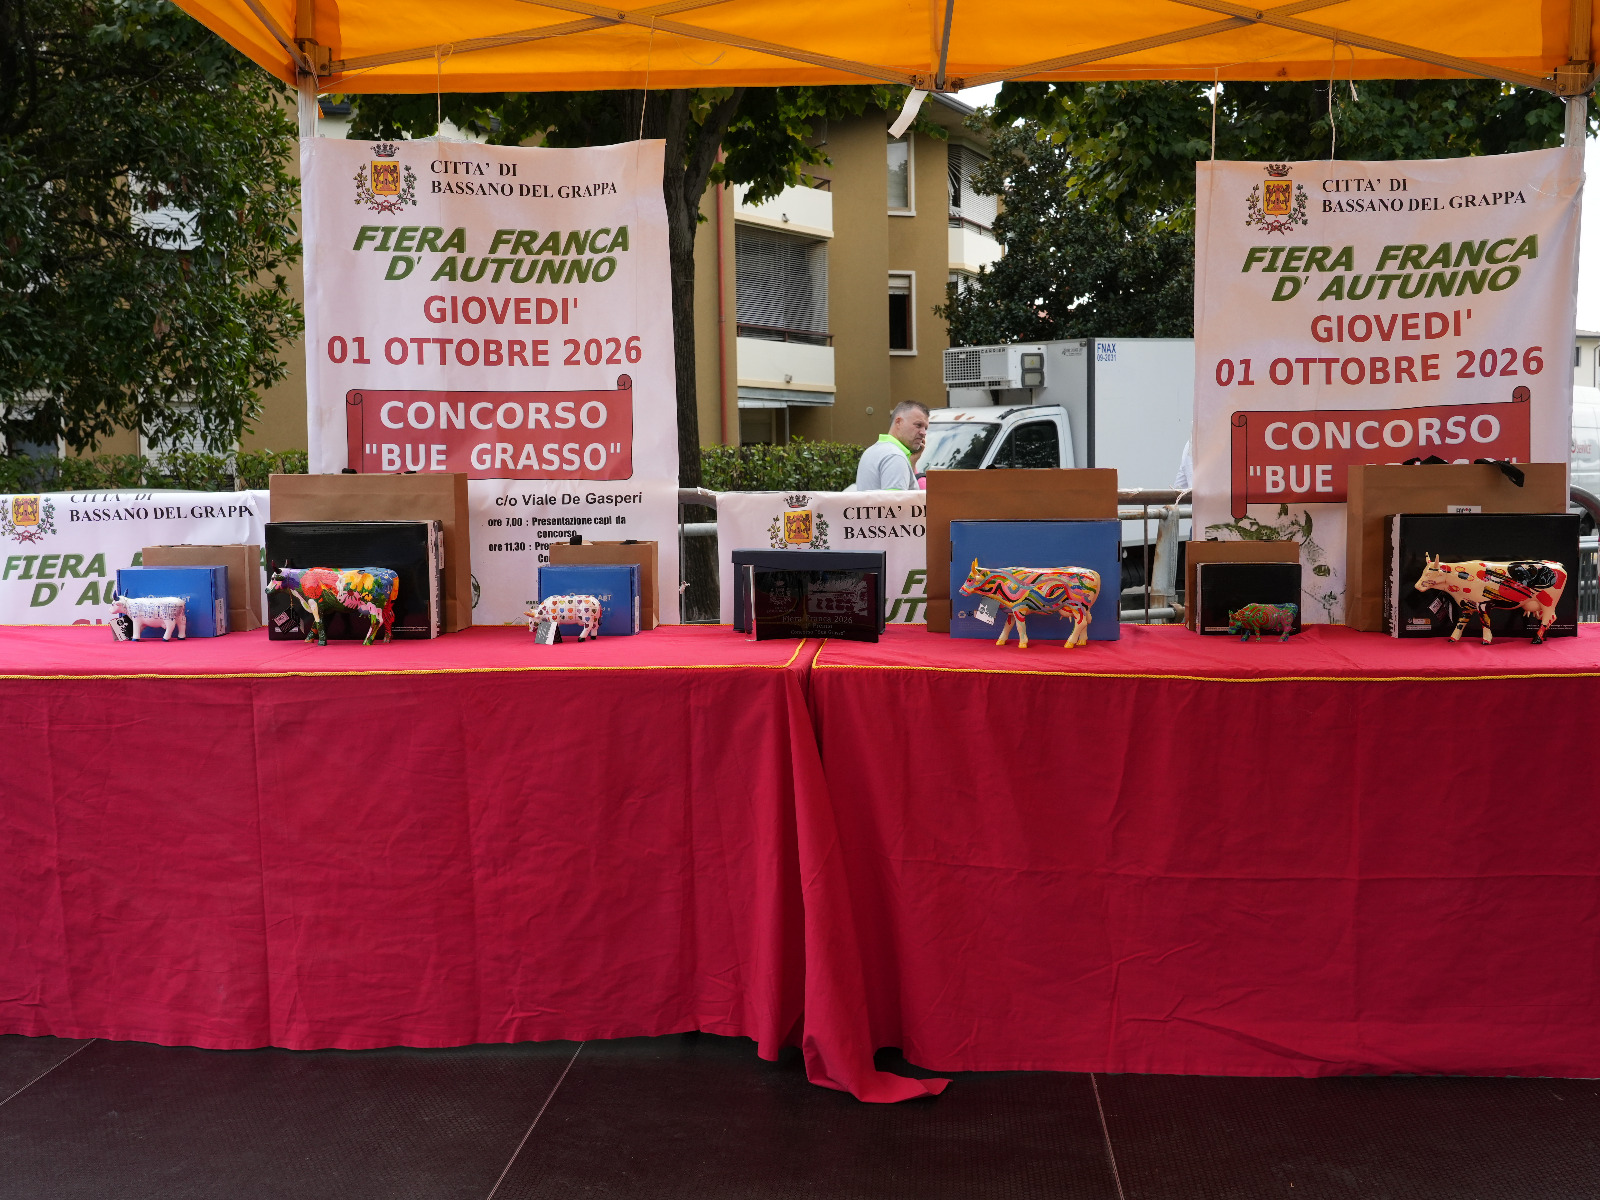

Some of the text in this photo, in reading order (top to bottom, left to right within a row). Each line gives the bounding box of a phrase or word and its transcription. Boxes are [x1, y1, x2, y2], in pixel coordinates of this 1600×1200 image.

[430, 159, 518, 177] CITTA' DI
[431, 180, 618, 199] BASSANO DEL GRAPPA
[1322, 178, 1408, 193] CITTA' DI
[1321, 189, 1527, 214] BASSANO DEL GRAPPA
[352, 225, 630, 256] FIERA FRANCA
[1241, 234, 1539, 273] FIERA FRANCA
[384, 255, 618, 284] D' AUTUNNO
[1270, 264, 1522, 302] D' AUTUNNO
[423, 295, 579, 325] GIOVEDI'
[1310, 308, 1472, 343] GIOVEDI'
[327, 335, 642, 367] 01 OTTOBRE 2026
[1096, 343, 1116, 354] FNAX
[1215, 345, 1544, 386] 01 OTTOBRE 2026
[379, 400, 608, 430] CONCORSO
[1264, 414, 1501, 451] CONCORSO
[365, 442, 622, 472] "BUE GRASSO"
[1249, 463, 1334, 494] "BUE
[495, 492, 643, 507] c/o Viale De Gasperi
[843, 505, 902, 520] CITTA'
[70, 507, 149, 522] BASSANO
[154, 506, 188, 520] DEL
[488, 518, 502, 527] ore
[532, 516, 593, 526] Presentazione
[594, 516, 612, 526] capi
[616, 515, 626, 525] da
[537, 529, 577, 538] concorso
[844, 524, 926, 540] BASSANO
[488, 543, 503, 551] ore
[2, 552, 107, 580] FIERA
[30, 582, 65, 608] D'
